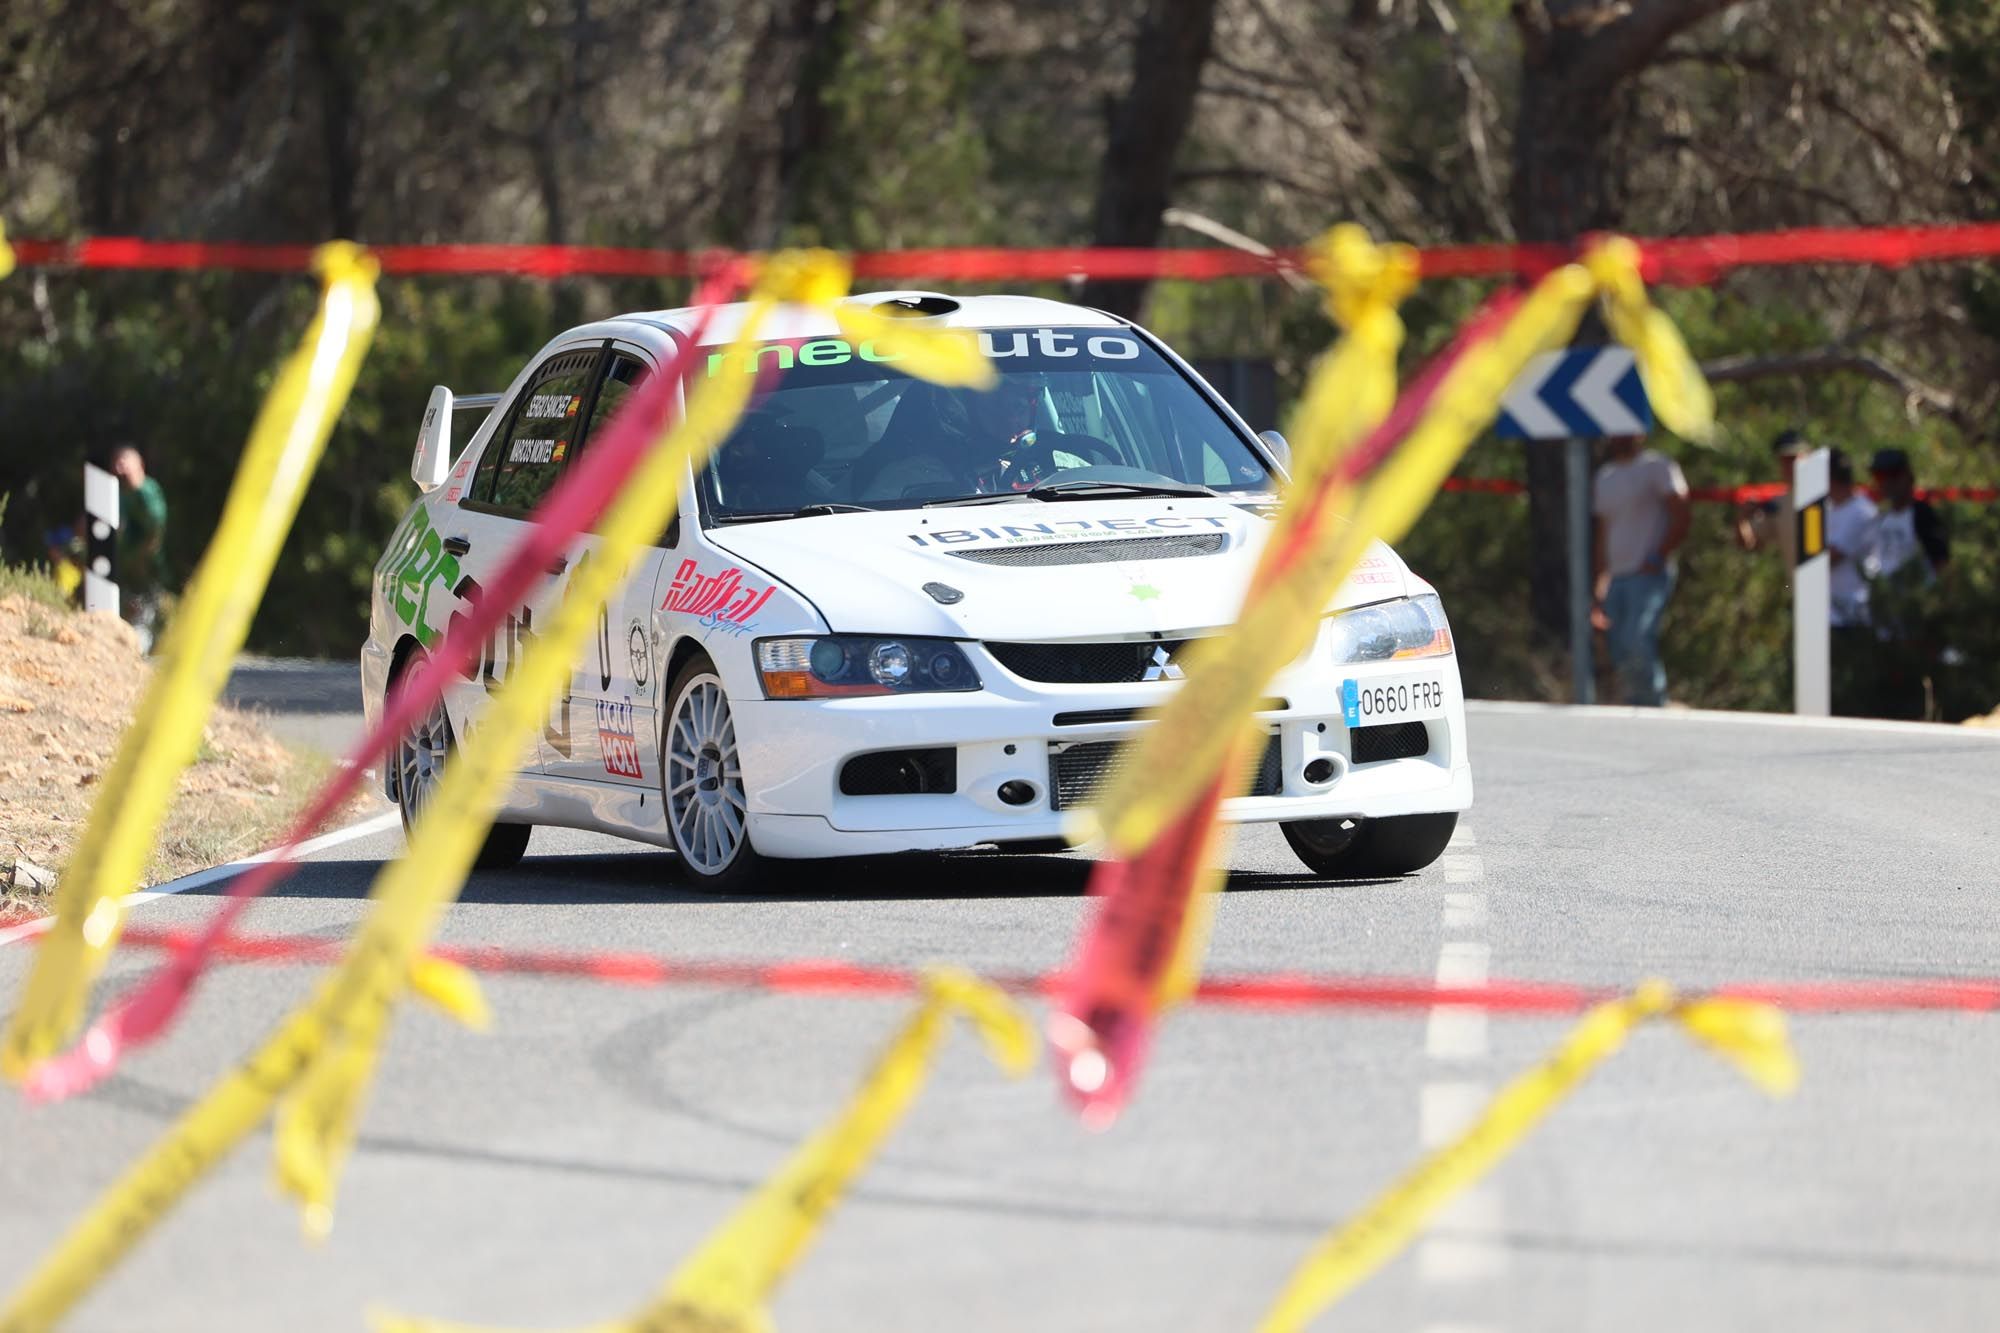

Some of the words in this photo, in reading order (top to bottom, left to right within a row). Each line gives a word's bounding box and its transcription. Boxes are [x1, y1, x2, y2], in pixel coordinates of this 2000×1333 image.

[707, 329, 1139, 378] mecuto
[907, 516, 1229, 547] IBINJECT
[699, 608, 759, 641] Sport
[1348, 707, 1356, 718] E
[1361, 684, 1408, 716] 0660
[1412, 681, 1442, 711] FRB
[601, 735, 638, 774] MOLY
